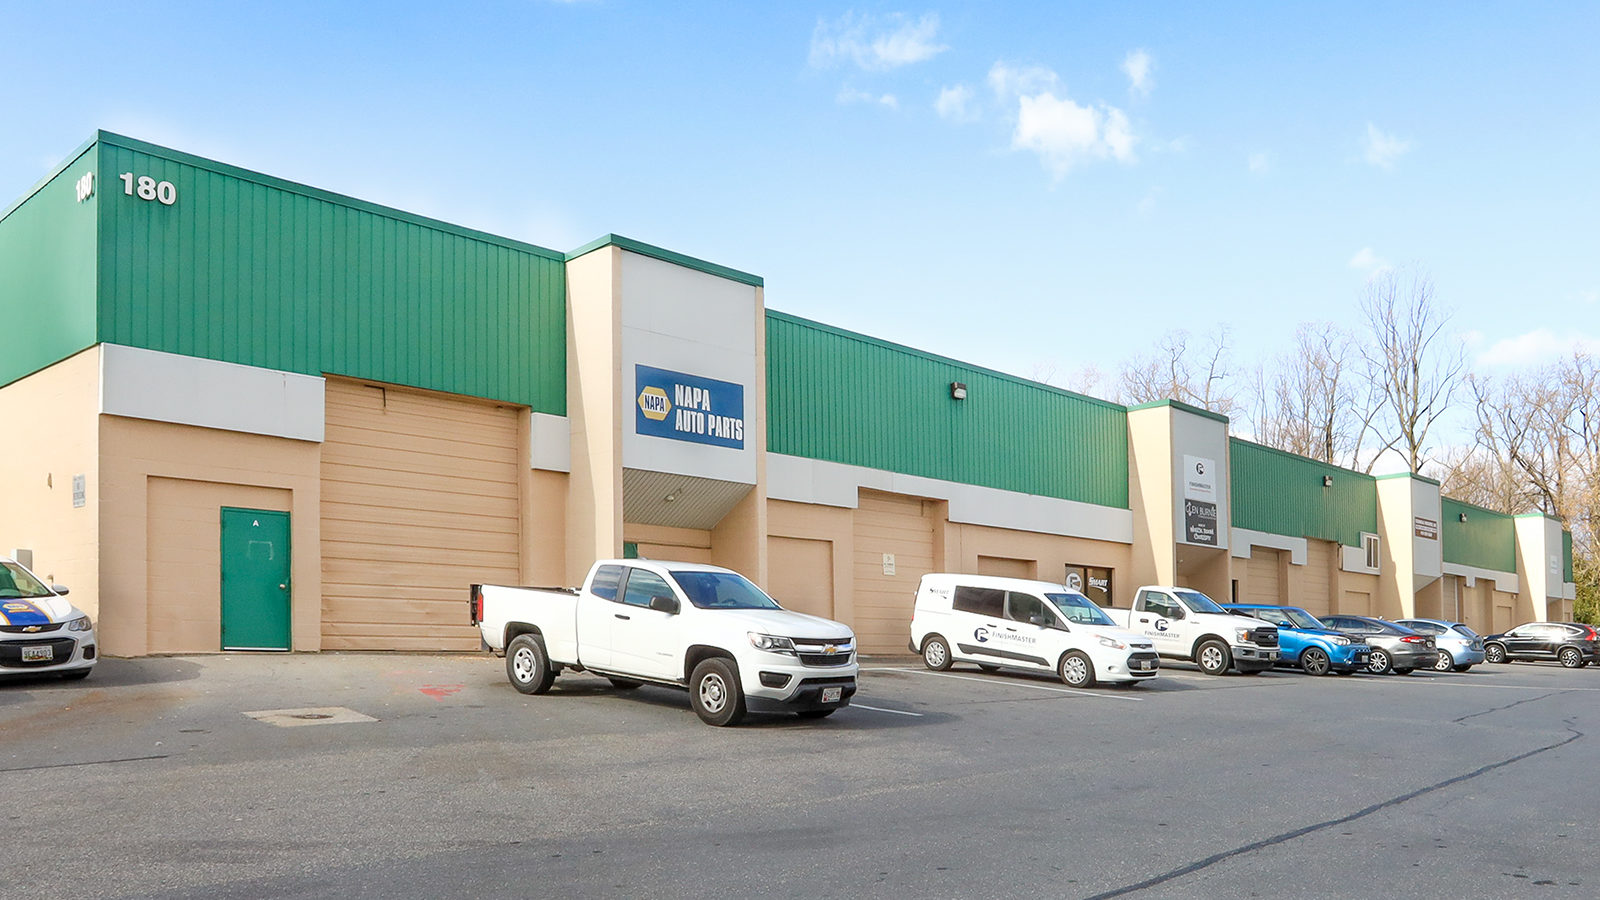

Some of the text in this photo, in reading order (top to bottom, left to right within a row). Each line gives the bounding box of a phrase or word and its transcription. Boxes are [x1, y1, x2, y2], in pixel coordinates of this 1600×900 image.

[120, 172, 176, 205] 180
[644, 394, 665, 412] NAPA
[675, 384, 710, 411] NAPA
[675, 409, 743, 441] AUTO PARTS
[252, 519, 260, 527] A
[1089, 576, 1107, 587] SMART
